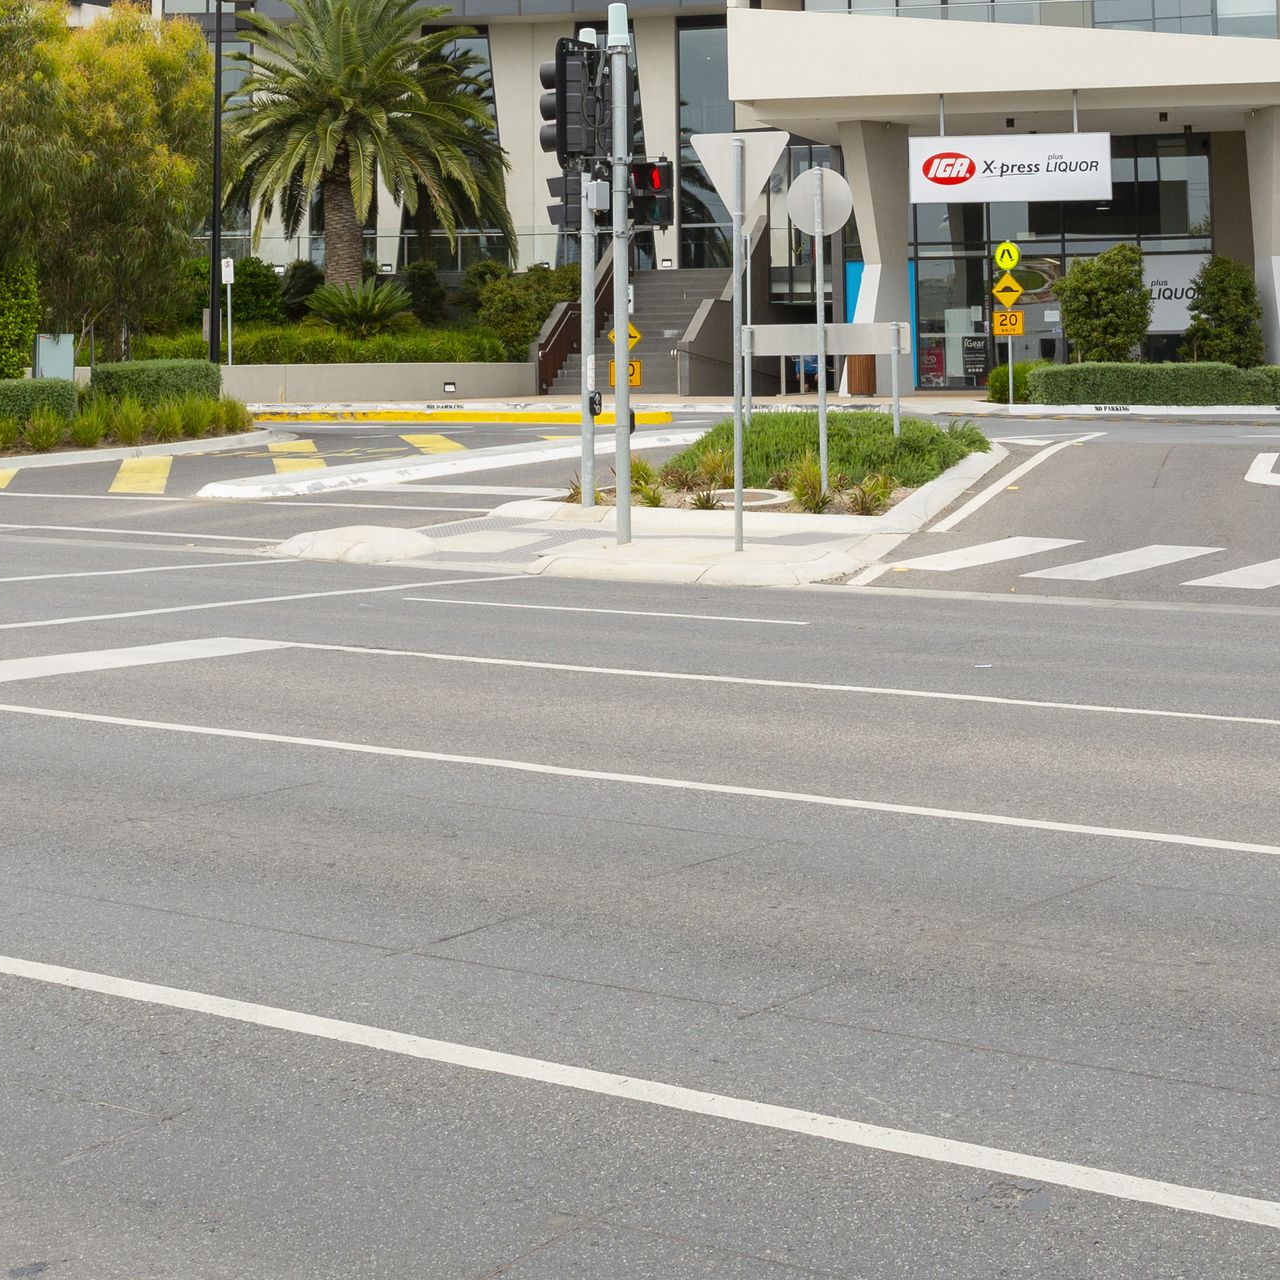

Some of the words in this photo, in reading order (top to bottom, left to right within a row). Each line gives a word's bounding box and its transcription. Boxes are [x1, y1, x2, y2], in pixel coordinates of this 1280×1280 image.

[1047, 153, 1064, 161] plus
[927, 158, 970, 179] IGA
[1046, 160, 1099, 173] LIQUOR
[1150, 279, 1168, 287] plus
[1150, 287, 1198, 300] LIQUO
[999, 313, 1018, 326] 20
